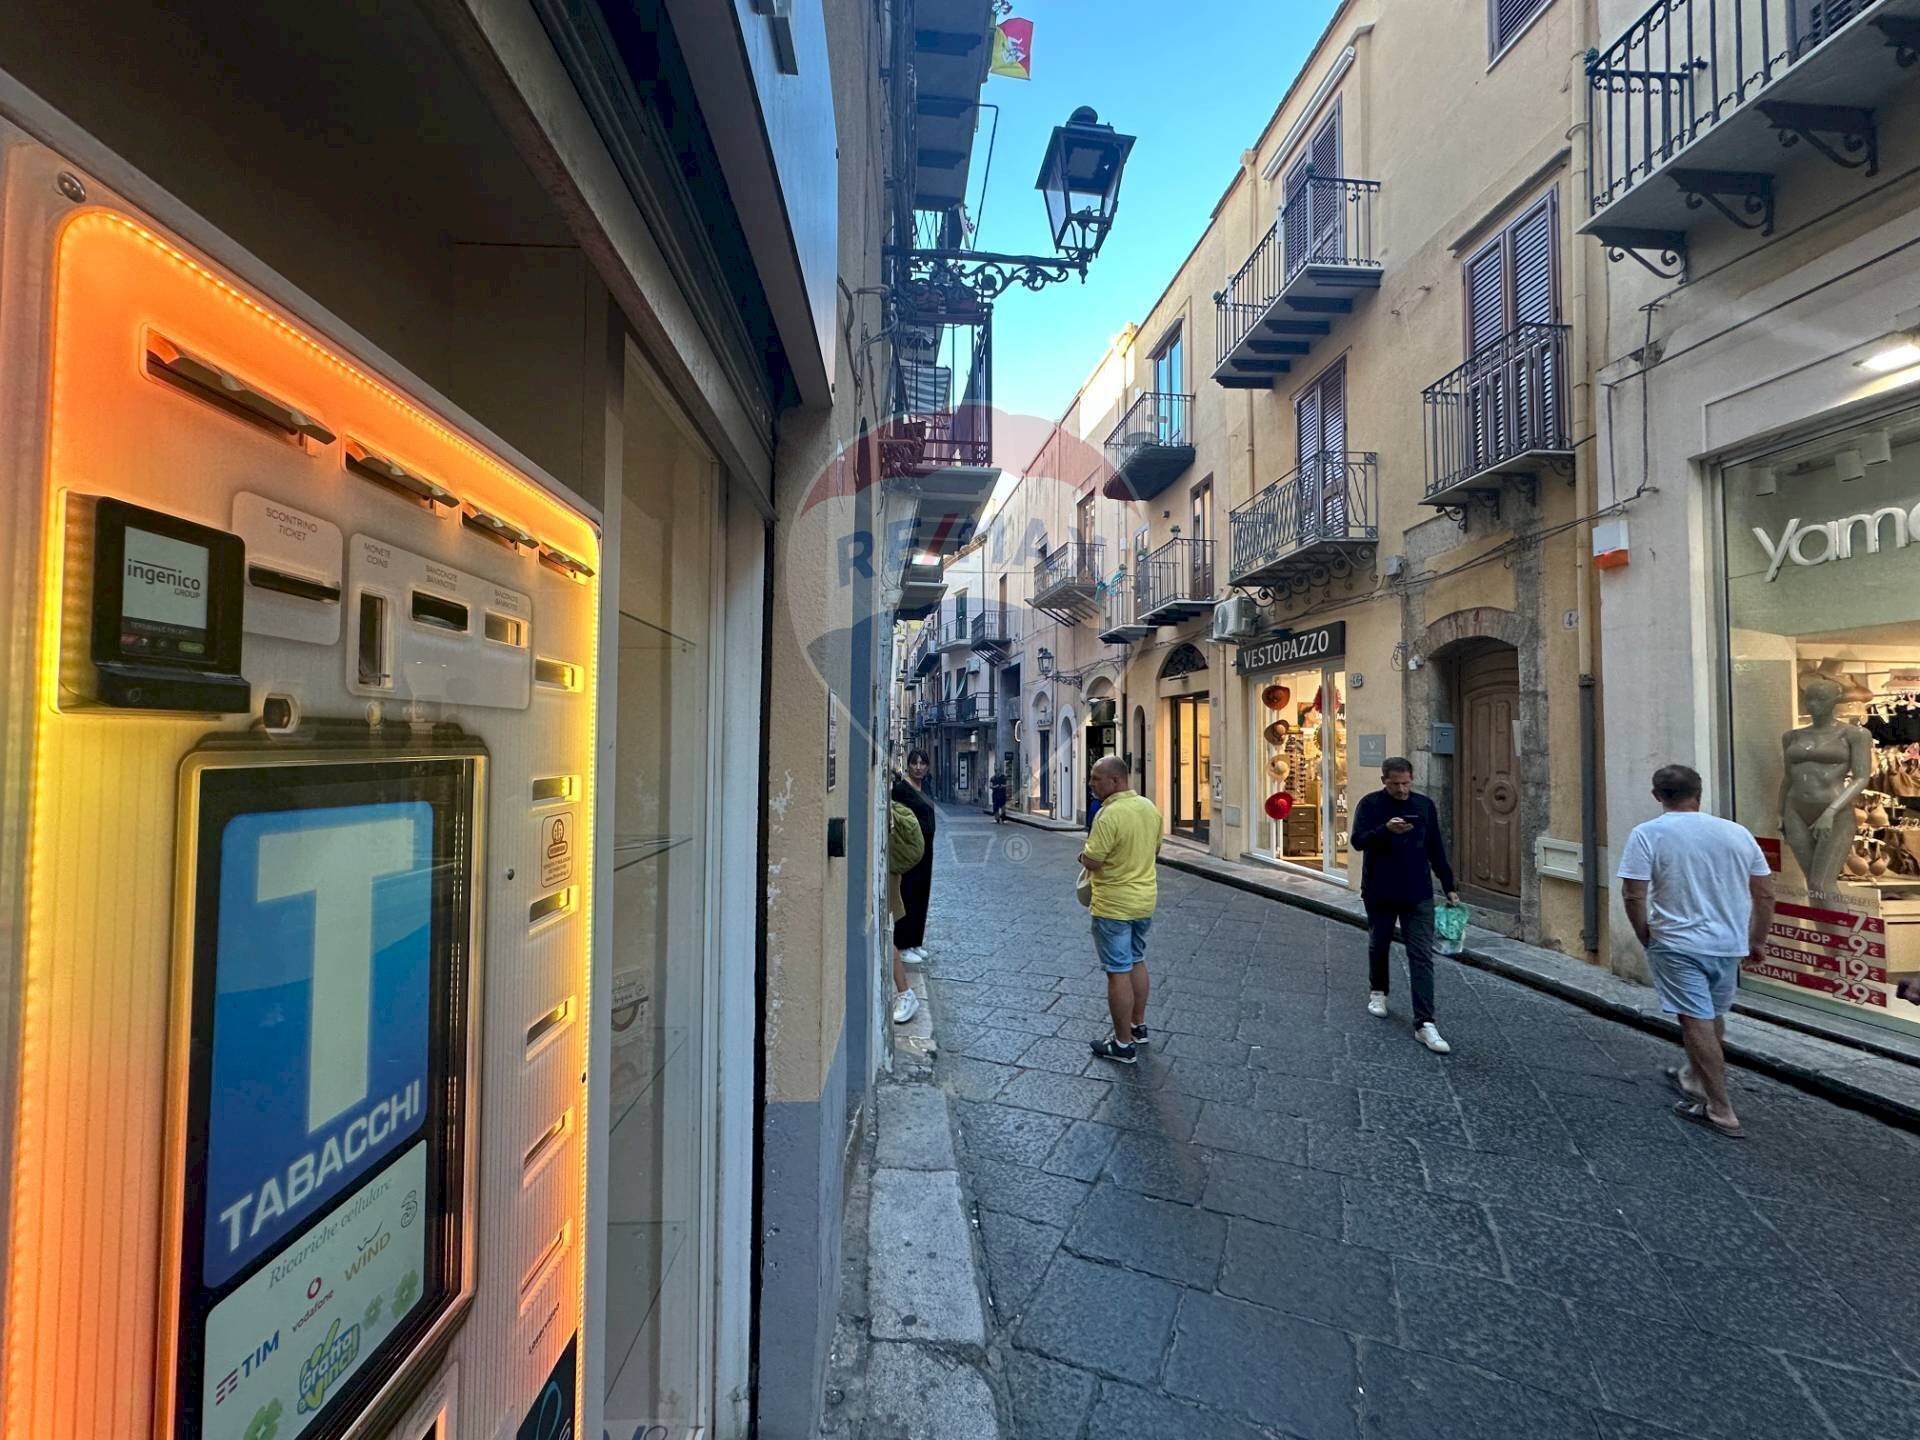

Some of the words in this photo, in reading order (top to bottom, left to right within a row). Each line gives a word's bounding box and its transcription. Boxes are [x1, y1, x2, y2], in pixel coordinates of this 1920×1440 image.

[266, 507, 318, 533] SCONTRINO
[279, 525, 307, 541] TICKET
[127, 558, 201, 590] ingenico
[174, 588, 201, 600] GROUP
[1243, 630, 1329, 670] VESTOPAZZO
[256, 818, 415, 1135] T
[1763, 945, 1817, 966] GGISENI
[1835, 955, 1869, 982] 19
[1832, 978, 1870, 1005] 29
[219, 1079, 420, 1253] TABACCHI
[268, 1222, 338, 1289] Ricariche
[344, 1231, 391, 1281] WIND
[292, 1289, 335, 1333] vodafone
[241, 1329, 280, 1378] TIM
